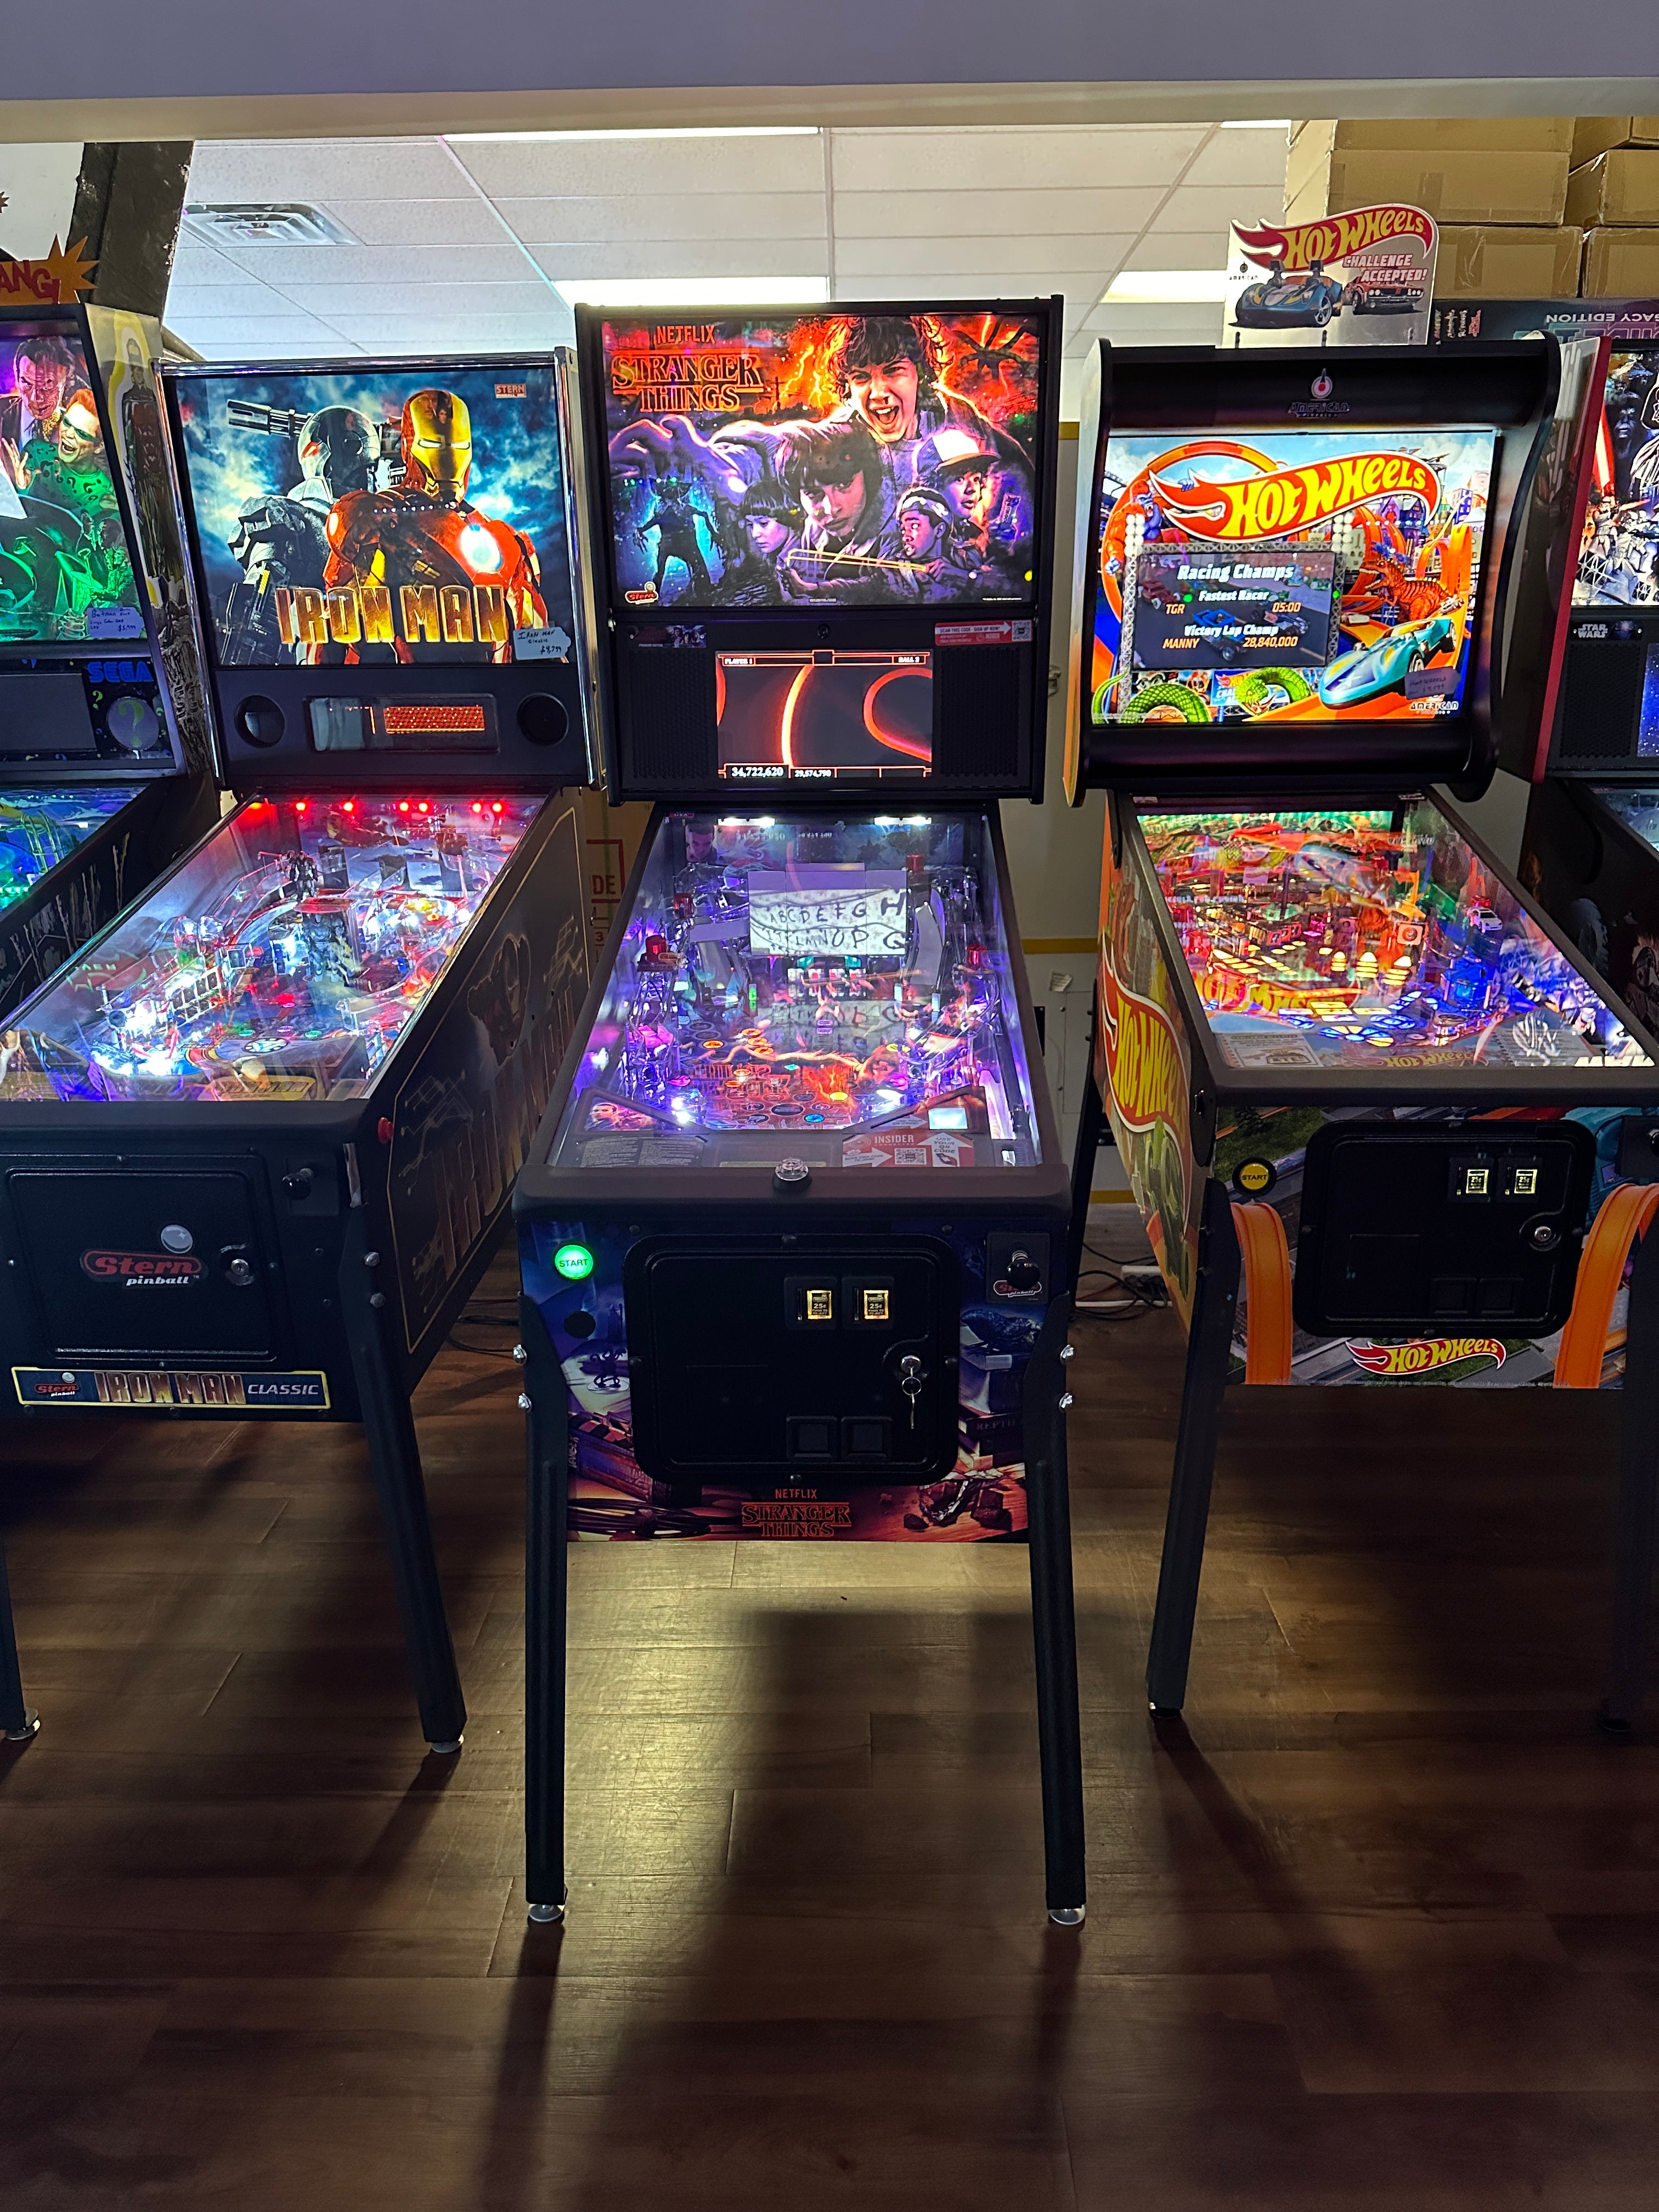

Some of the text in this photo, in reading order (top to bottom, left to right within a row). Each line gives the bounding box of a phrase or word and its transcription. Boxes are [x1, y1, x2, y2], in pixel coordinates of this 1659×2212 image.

[1278, 209, 1425, 269] HOT WHEELS
[1342, 255, 1413, 268] CHALLENGE
[1361, 269, 1427, 282] ACCEPTED!
[1546, 313, 1615, 323] EDITION
[656, 325, 715, 344] NETFLIX
[611, 354, 764, 389] STRANGER
[496, 385, 524, 393] STERN
[636, 385, 741, 411] THINGS
[1216, 456, 1426, 536] HOT WHEELS
[1177, 563, 1295, 583] Racing Champs
[1198, 590, 1270, 601] Fastest Racer
[92, 609, 116, 618] Batman
[275, 585, 508, 644] IRON MAN
[1165, 602, 1301, 614] TGR 05:00
[1184, 624, 1279, 637] Victory Lap Champ
[1578, 630, 1607, 639] WARS
[1163, 636, 1299, 649] MANNY 28,840,000
[87, 661, 154, 682] SEGA
[1409, 701, 1459, 710] AMERICAN
[731, 766, 784, 778] 34,722,620
[770, 891, 906, 924] A B C D E F G H
[853, 928, 870, 949] P
[1384, 1055, 1421, 1067] HOT
[1113, 990, 1186, 1149] HOT WHEELS
[874, 1135, 915, 1144] INSIDER
[95, 1257, 194, 1275] Stern
[559, 1259, 589, 1267] START
[126, 1276, 189, 1286] pinball
[1385, 1339, 1498, 1372] HOT WHEELS
[37, 1385, 77, 1393] Stern
[94, 1372, 246, 1405] IRON MAN
[247, 1384, 319, 1395] CLASSIC
[775, 1488, 817, 1499] NETFLIX
[742, 1504, 852, 1523] STRANGER
[759, 1521, 834, 1537] THINGS
